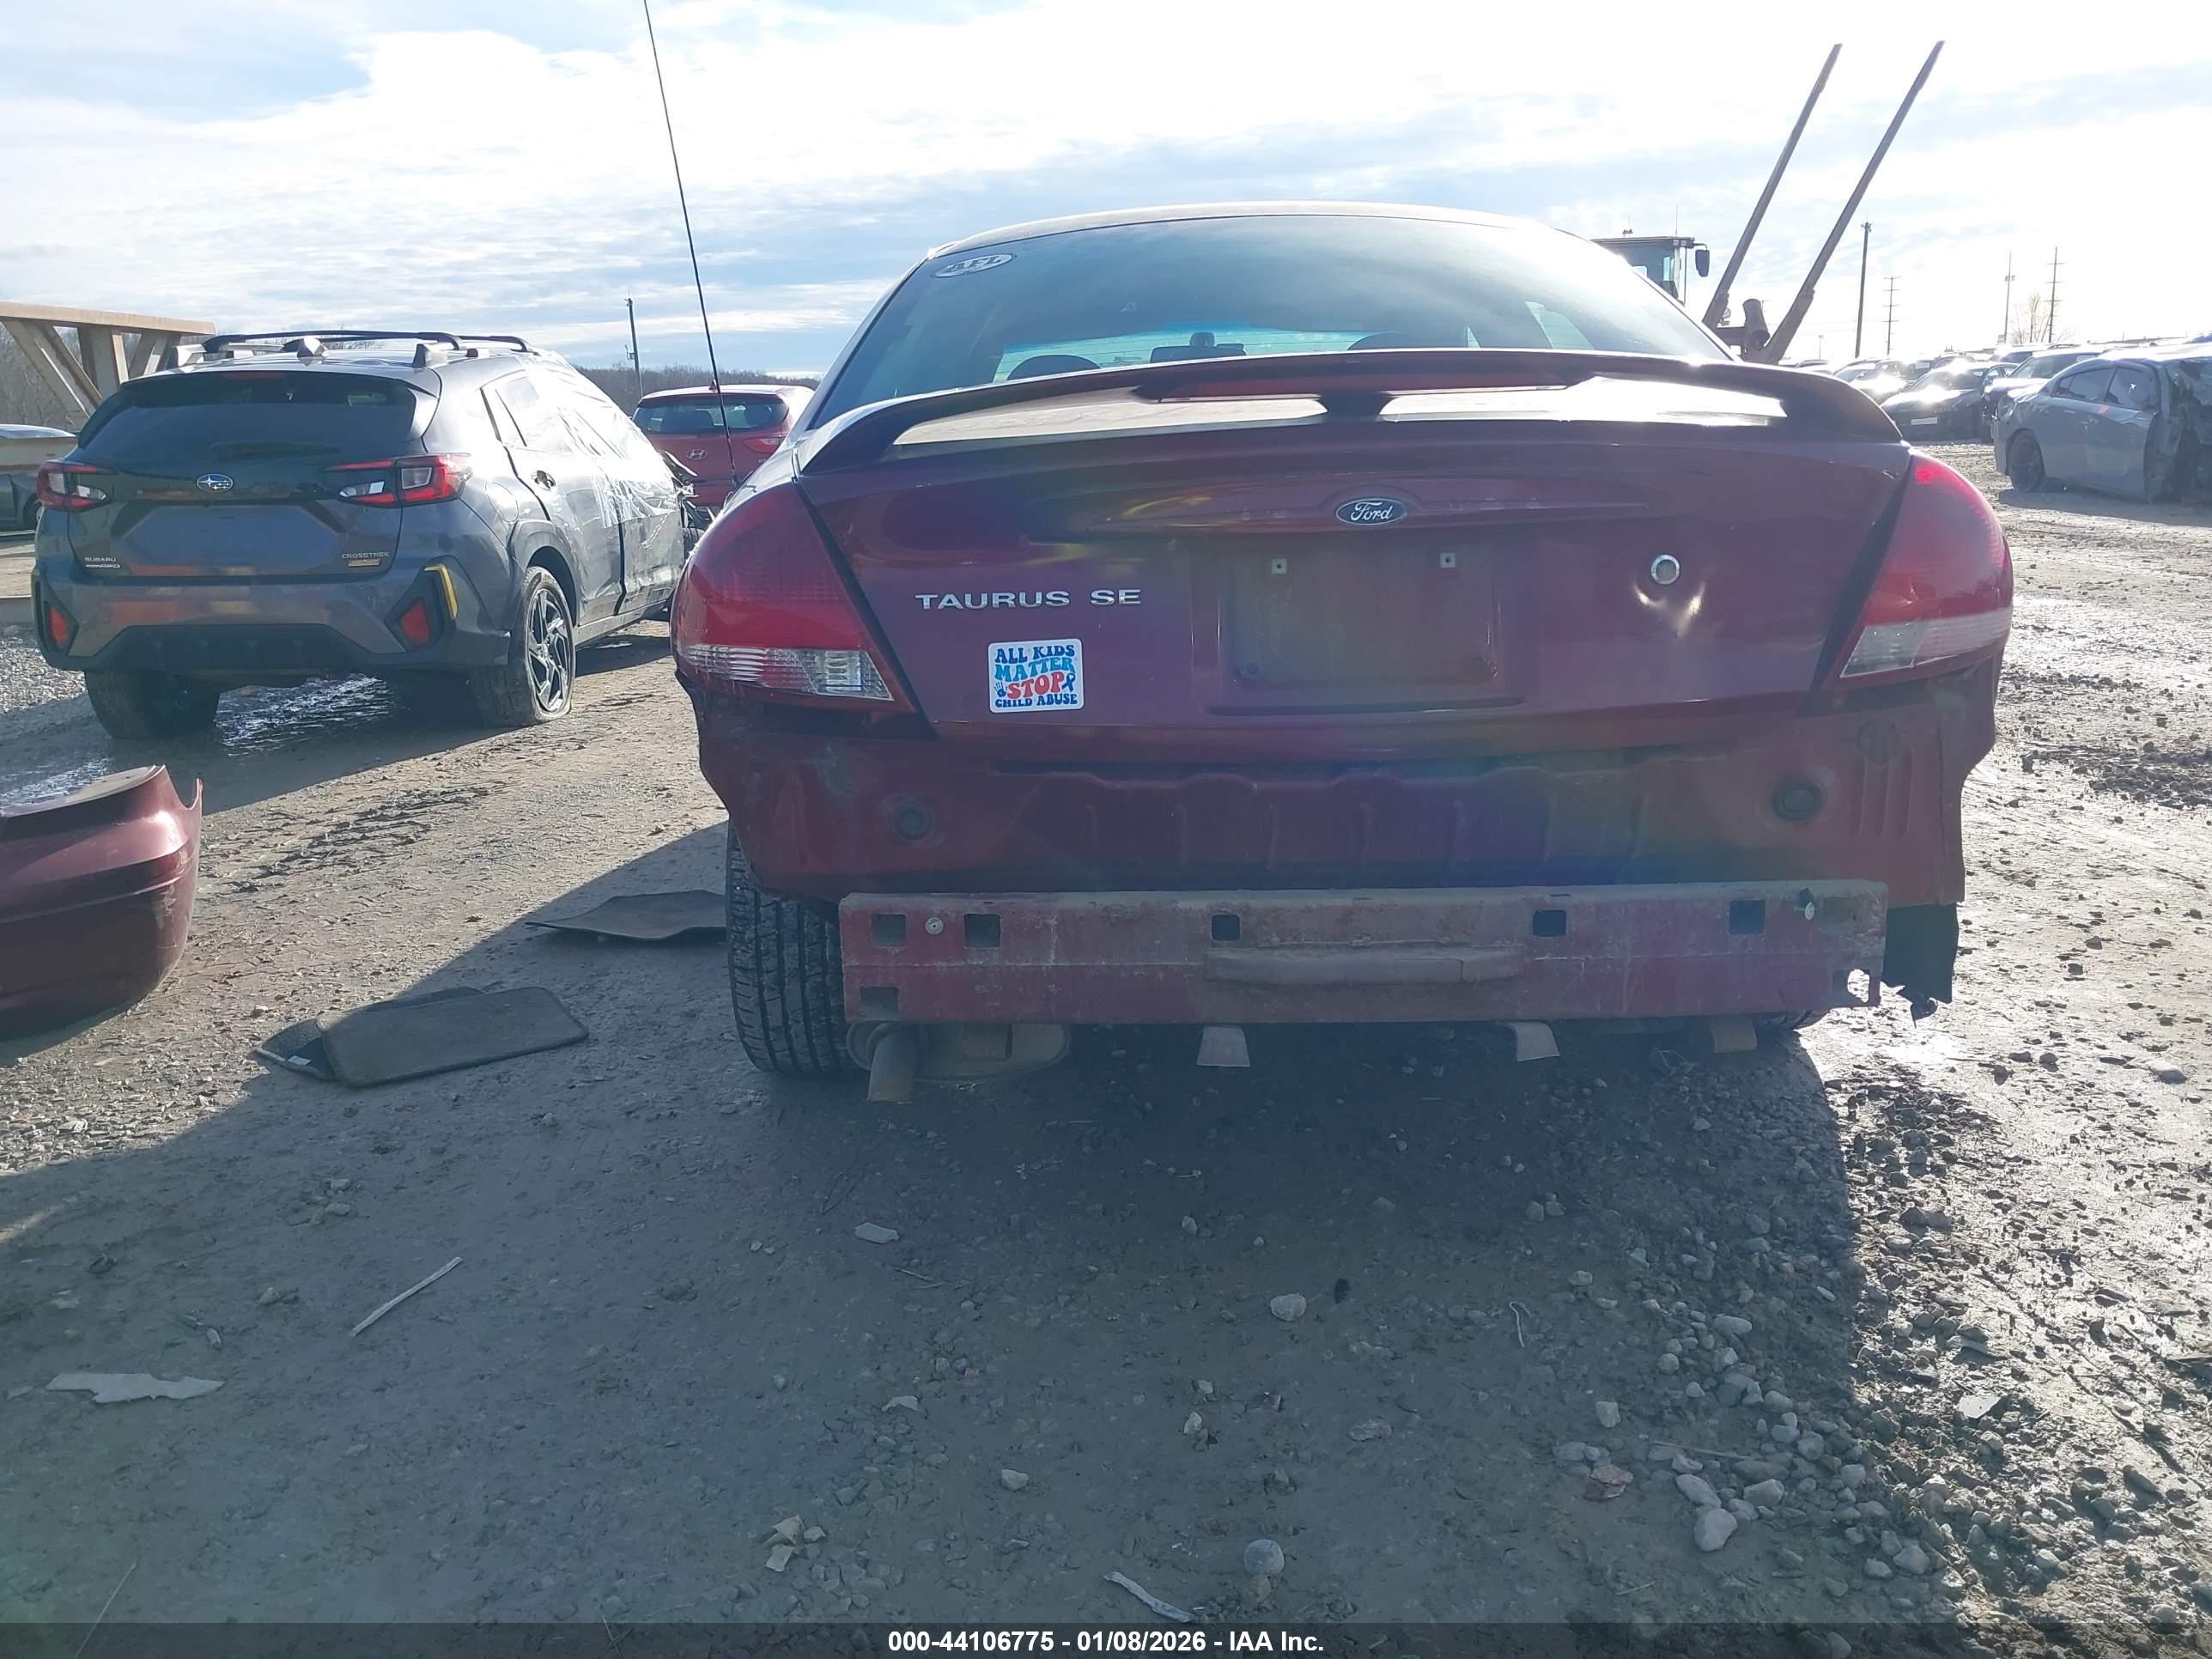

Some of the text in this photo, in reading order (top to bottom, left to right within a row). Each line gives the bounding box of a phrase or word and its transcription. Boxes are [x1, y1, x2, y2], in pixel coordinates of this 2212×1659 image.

[1350, 501, 1394, 521] Ford
[915, 589, 1141, 610] TAURUS SE
[994, 645, 1075, 665] ALL KIDS
[994, 657, 1076, 682] MATTER
[1006, 672, 1065, 699] STOP
[994, 694, 1078, 708] CHILD ABUSE
